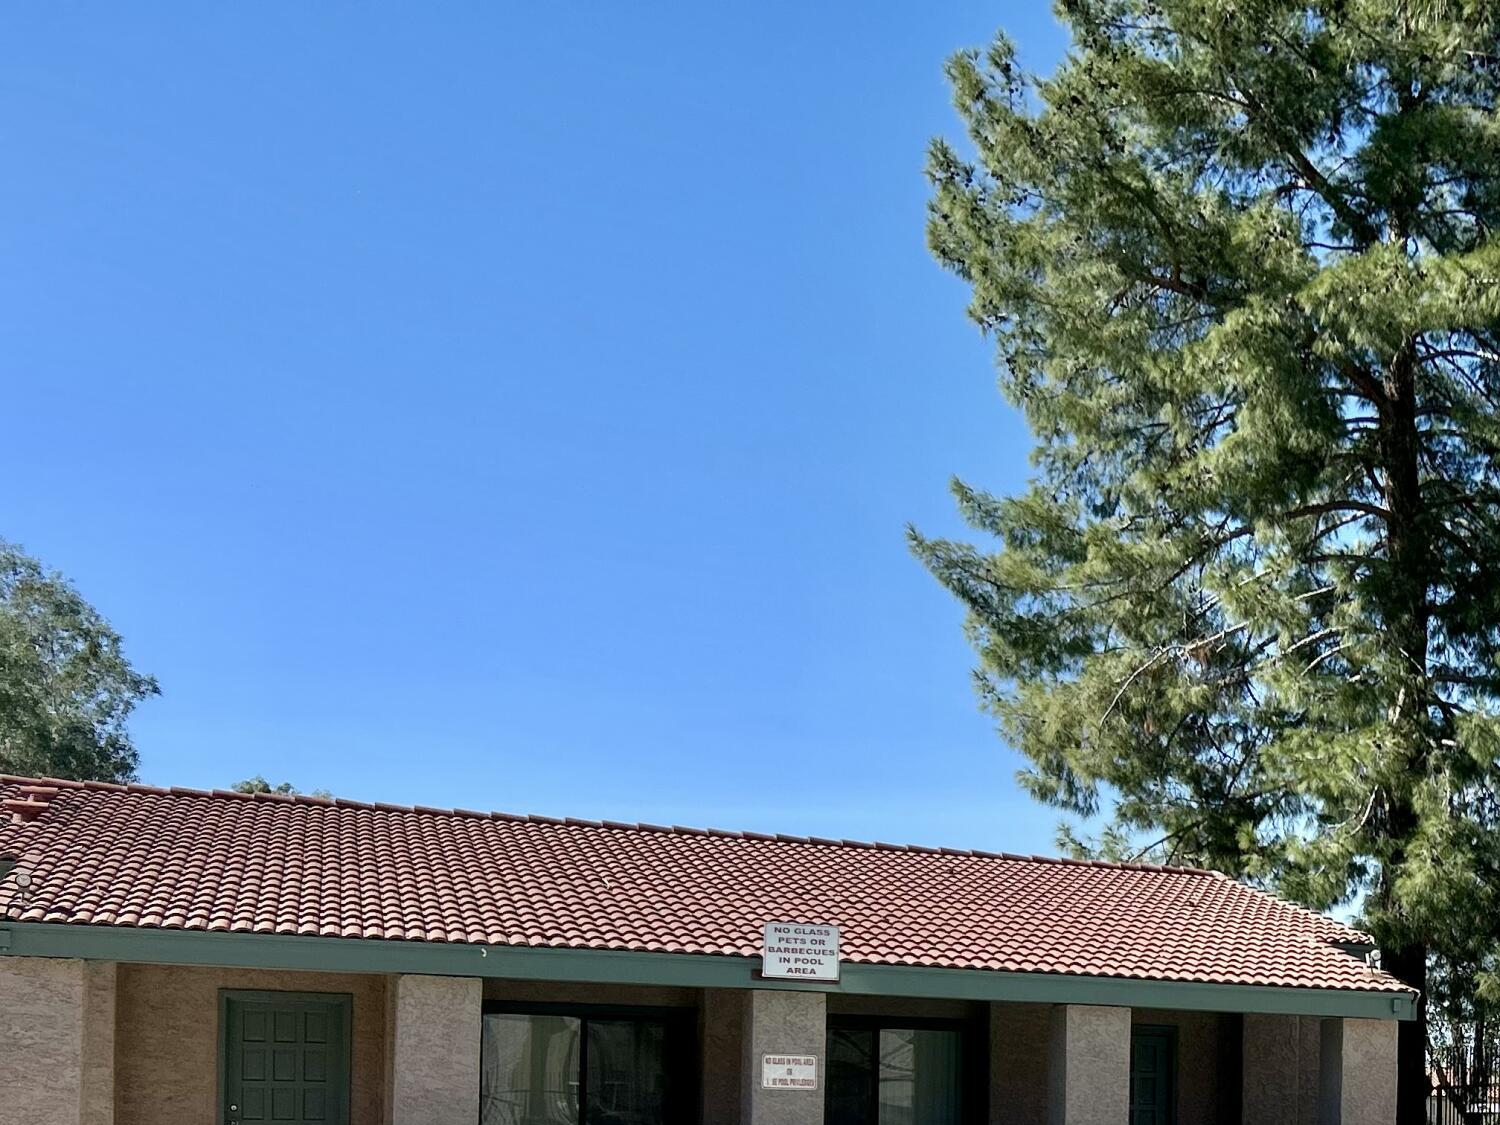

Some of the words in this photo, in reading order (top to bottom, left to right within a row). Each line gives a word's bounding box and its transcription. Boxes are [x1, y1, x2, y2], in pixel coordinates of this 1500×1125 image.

[774, 926, 790, 934] NO
[794, 927, 831, 937] GLASS
[778, 936, 807, 945] PETS
[810, 938, 826, 946] OR
[767, 946, 835, 956] BARBECUES
[794, 957, 824, 966] POOL
[786, 967, 817, 975] AREA
